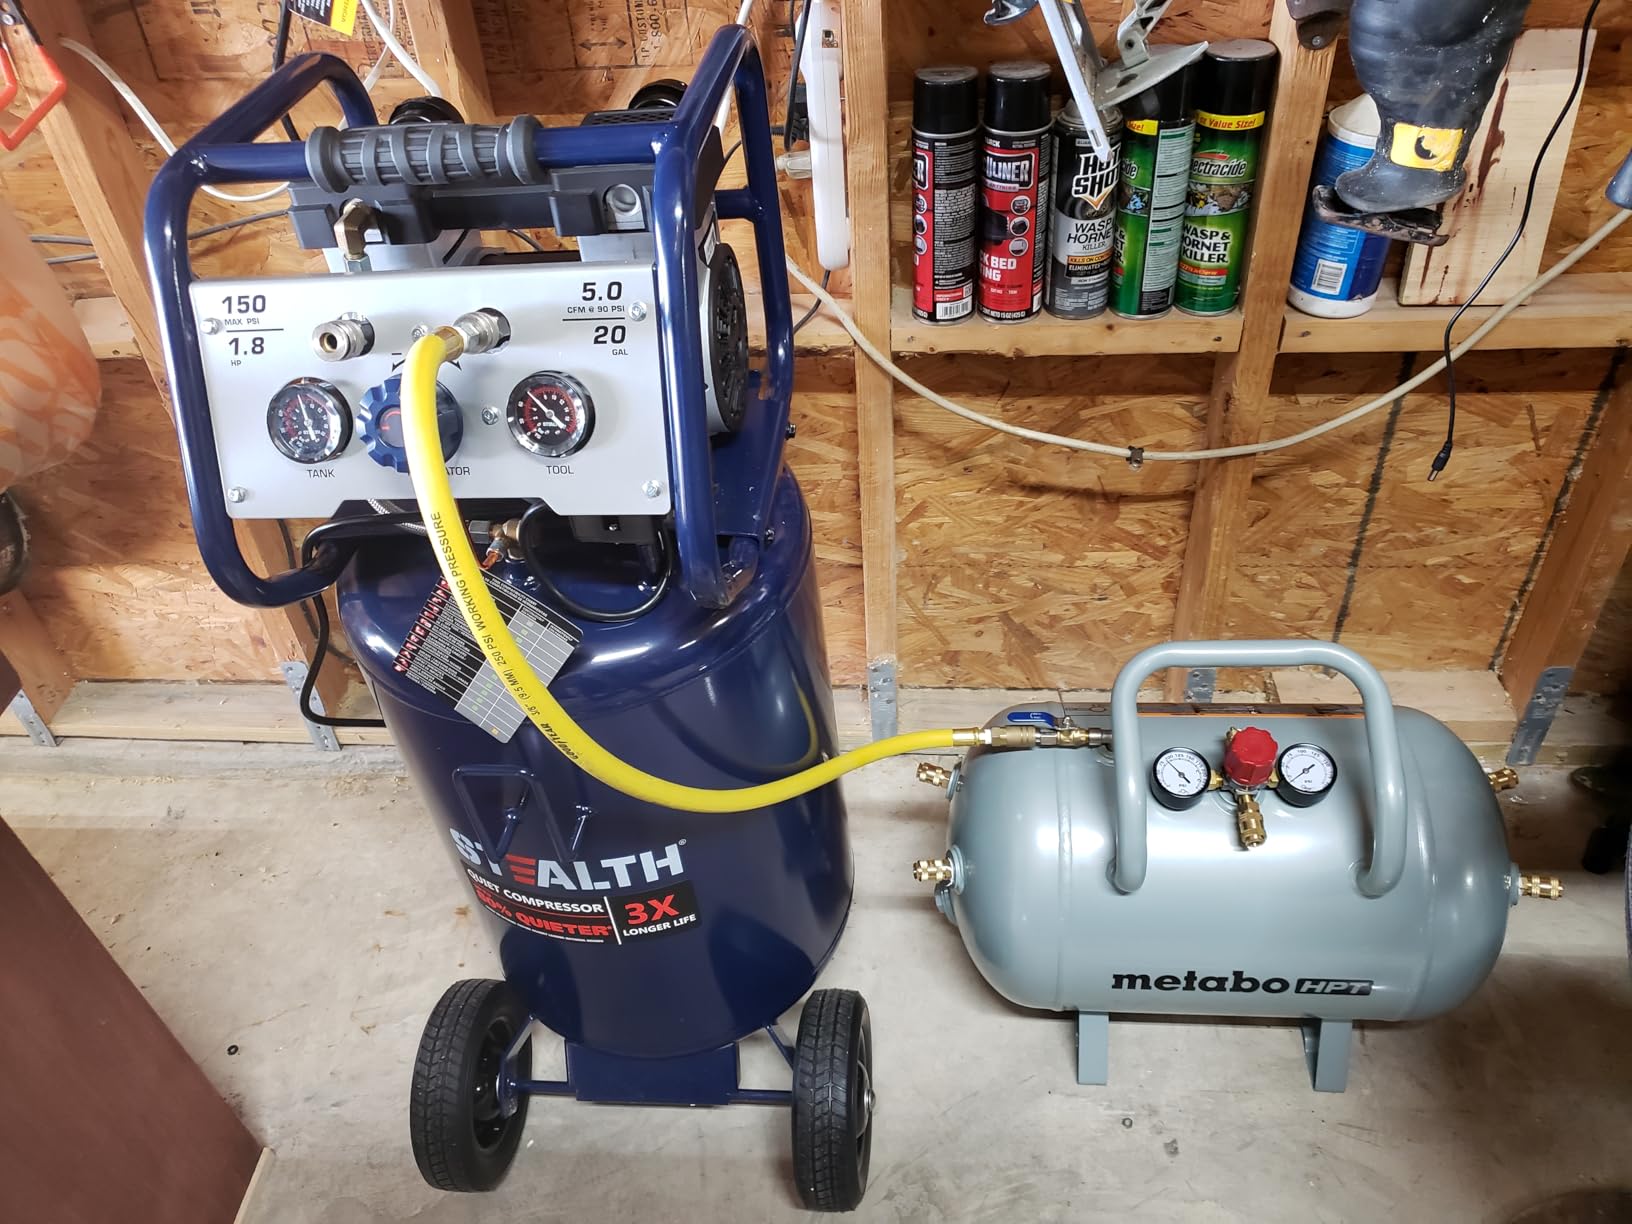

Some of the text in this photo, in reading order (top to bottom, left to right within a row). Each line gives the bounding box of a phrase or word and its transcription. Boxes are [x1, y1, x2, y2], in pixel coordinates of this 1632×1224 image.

[1209, 119, 1232, 129] Value
[1235, 118, 1257, 129] Size!
[1075, 217, 1112, 234] WASP
[1067, 228, 1112, 244] HORNE
[1220, 231, 1231, 241] &
[991, 255, 1017, 270] BED
[582, 281, 622, 302] 5.0
[222, 294, 266, 314] 150
[567, 306, 586, 314] CFM
[597, 305, 609, 313] 90
[611, 305, 625, 313] PSI
[224, 317, 260, 326] MAX PSI
[593, 325, 627, 345] 20
[228, 336, 265, 356] 1.8
[611, 348, 629, 356] GAL
[230, 359, 242, 367] HP
[306, 469, 336, 479] TANK
[546, 465, 574, 475] TOOL
[431, 512, 462, 577] PRESSURE
[456, 580, 487, 631] WORKING
[482, 634, 496, 650] PSI
[492, 652, 507, 666] 250
[467, 868, 500, 893] QUIET
[503, 889, 604, 914] COMPRESSOR
[624, 894, 680, 926] 3X
[623, 920, 672, 937] LONGER
[673, 913, 697, 928] LIFE
[1112, 970, 1370, 995] metabo HPT
